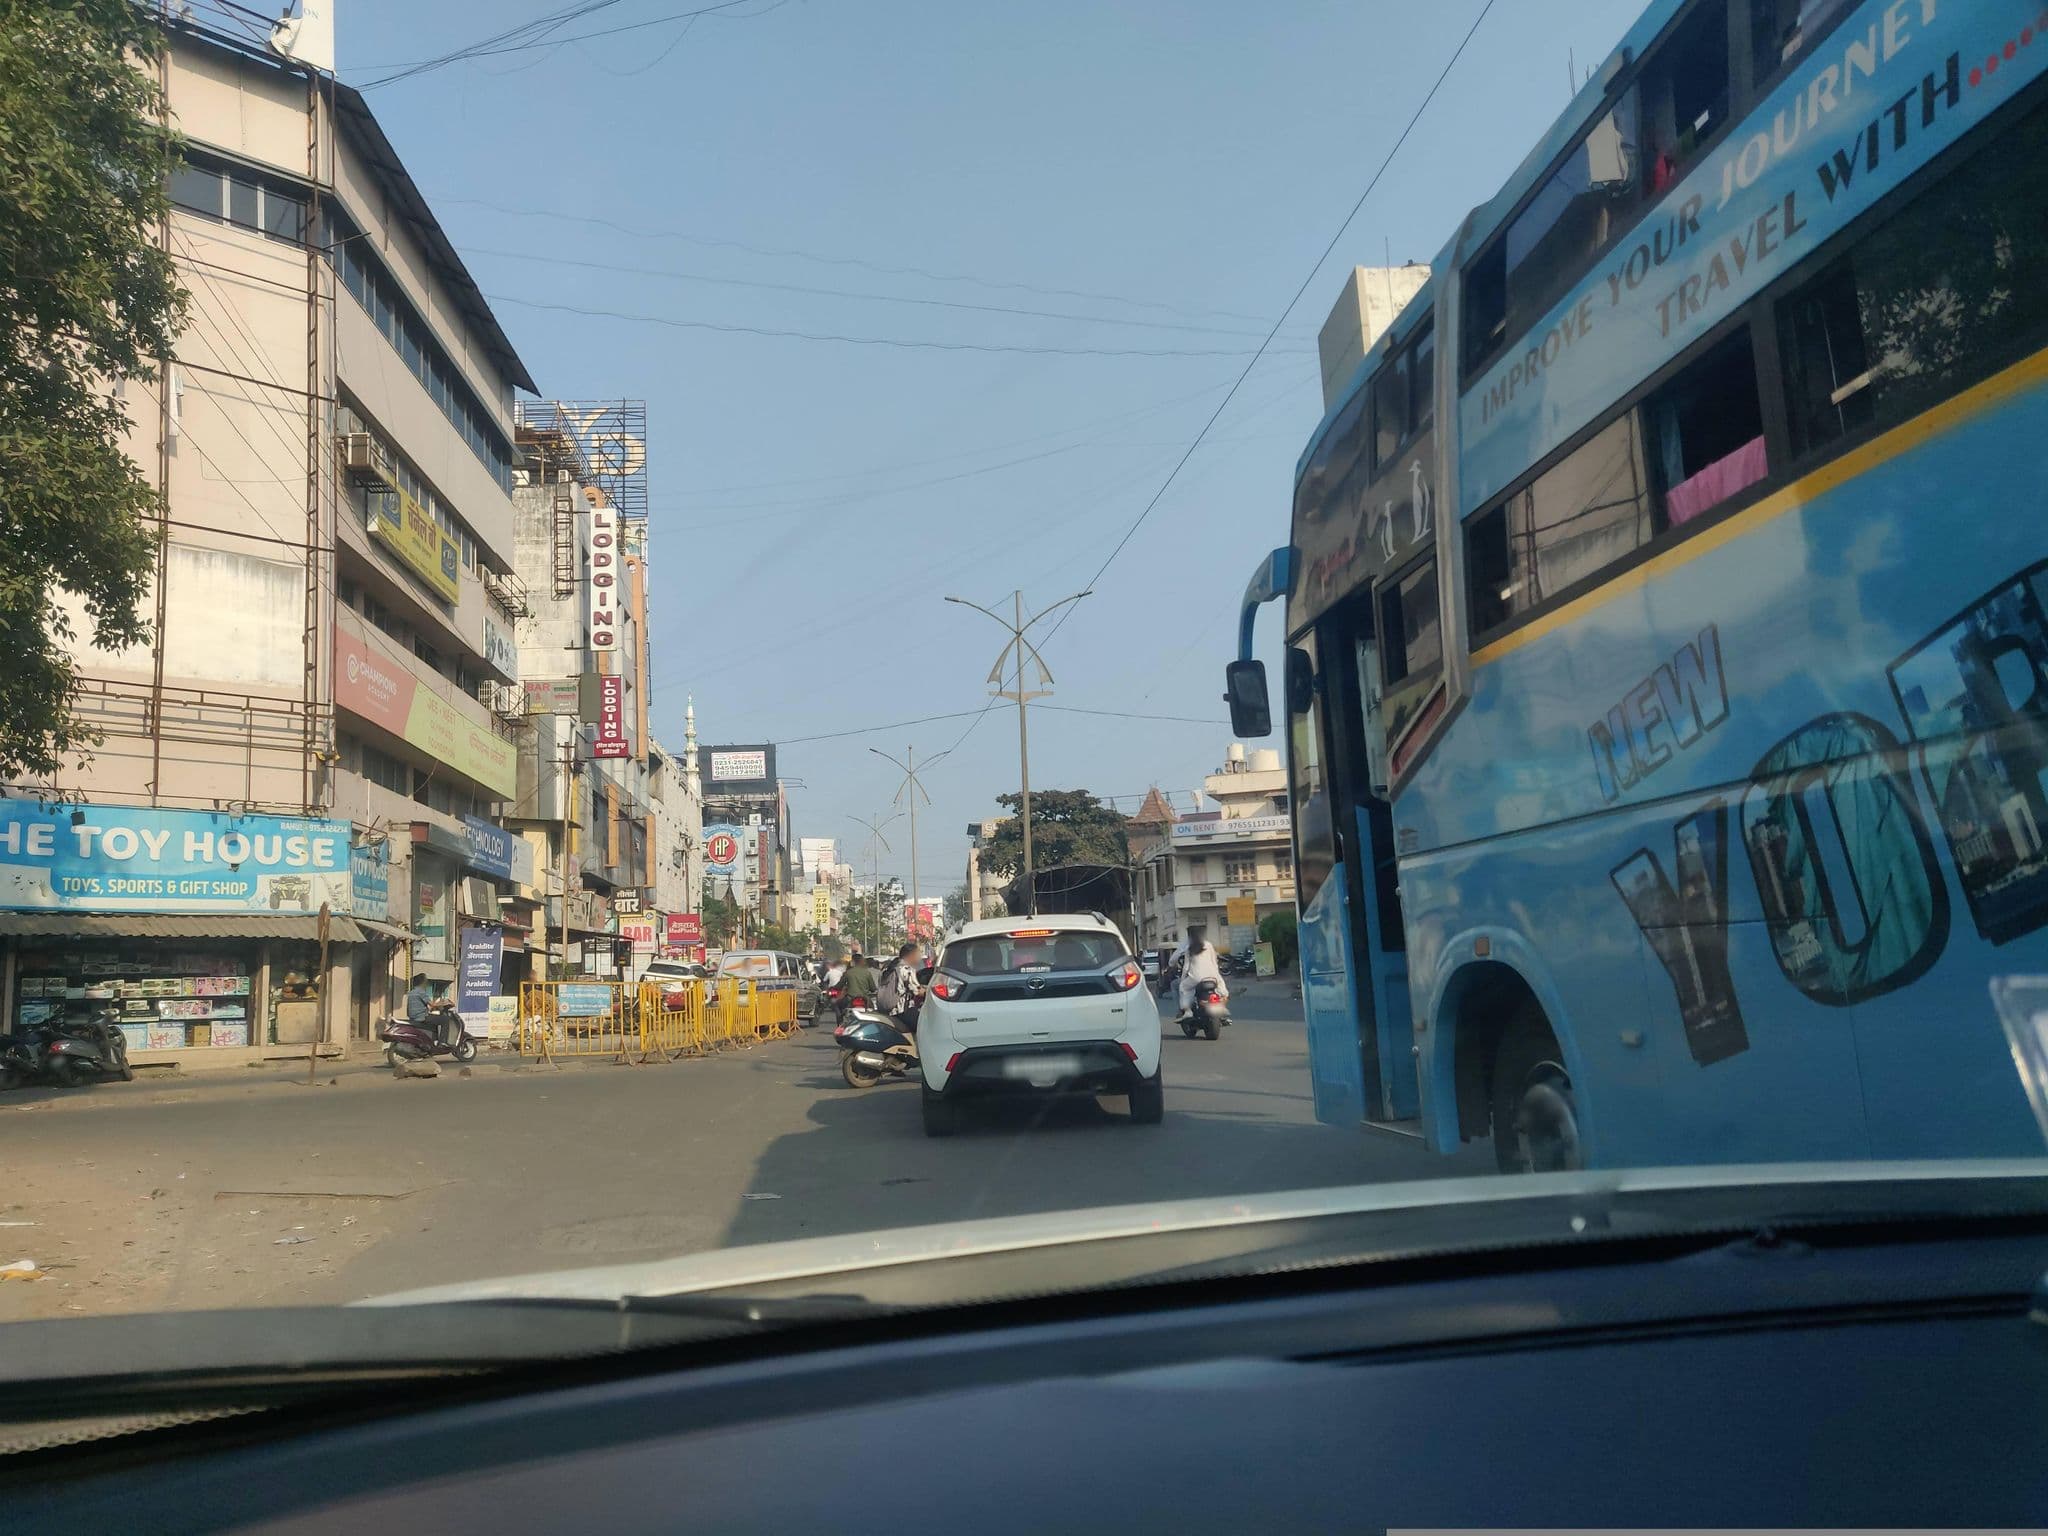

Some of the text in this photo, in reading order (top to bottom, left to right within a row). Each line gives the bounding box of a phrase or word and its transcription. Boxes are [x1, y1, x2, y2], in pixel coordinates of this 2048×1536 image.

[1482, 0, 1938, 424] IMPROVE YOUR JOURNEY
[1654, 190, 1809, 339] TRAVEL
[592, 513, 614, 646] LODGING
[527, 682, 550, 692] BAR
[603, 680, 617, 738] LODGING
[1587, 622, 1731, 806] NEW
[1193, 824, 1215, 832] RENT
[1228, 820, 1276, 829] 9765511233
[71, 825, 171, 861] TOY
[183, 831, 335, 867] HOUSE
[714, 838, 729, 856] HP
[62, 877, 248, 896] TOYS, SPORTS & GIFT SHOP
[614, 899, 639, 912] बार
[623, 926, 652, 942] BAR
